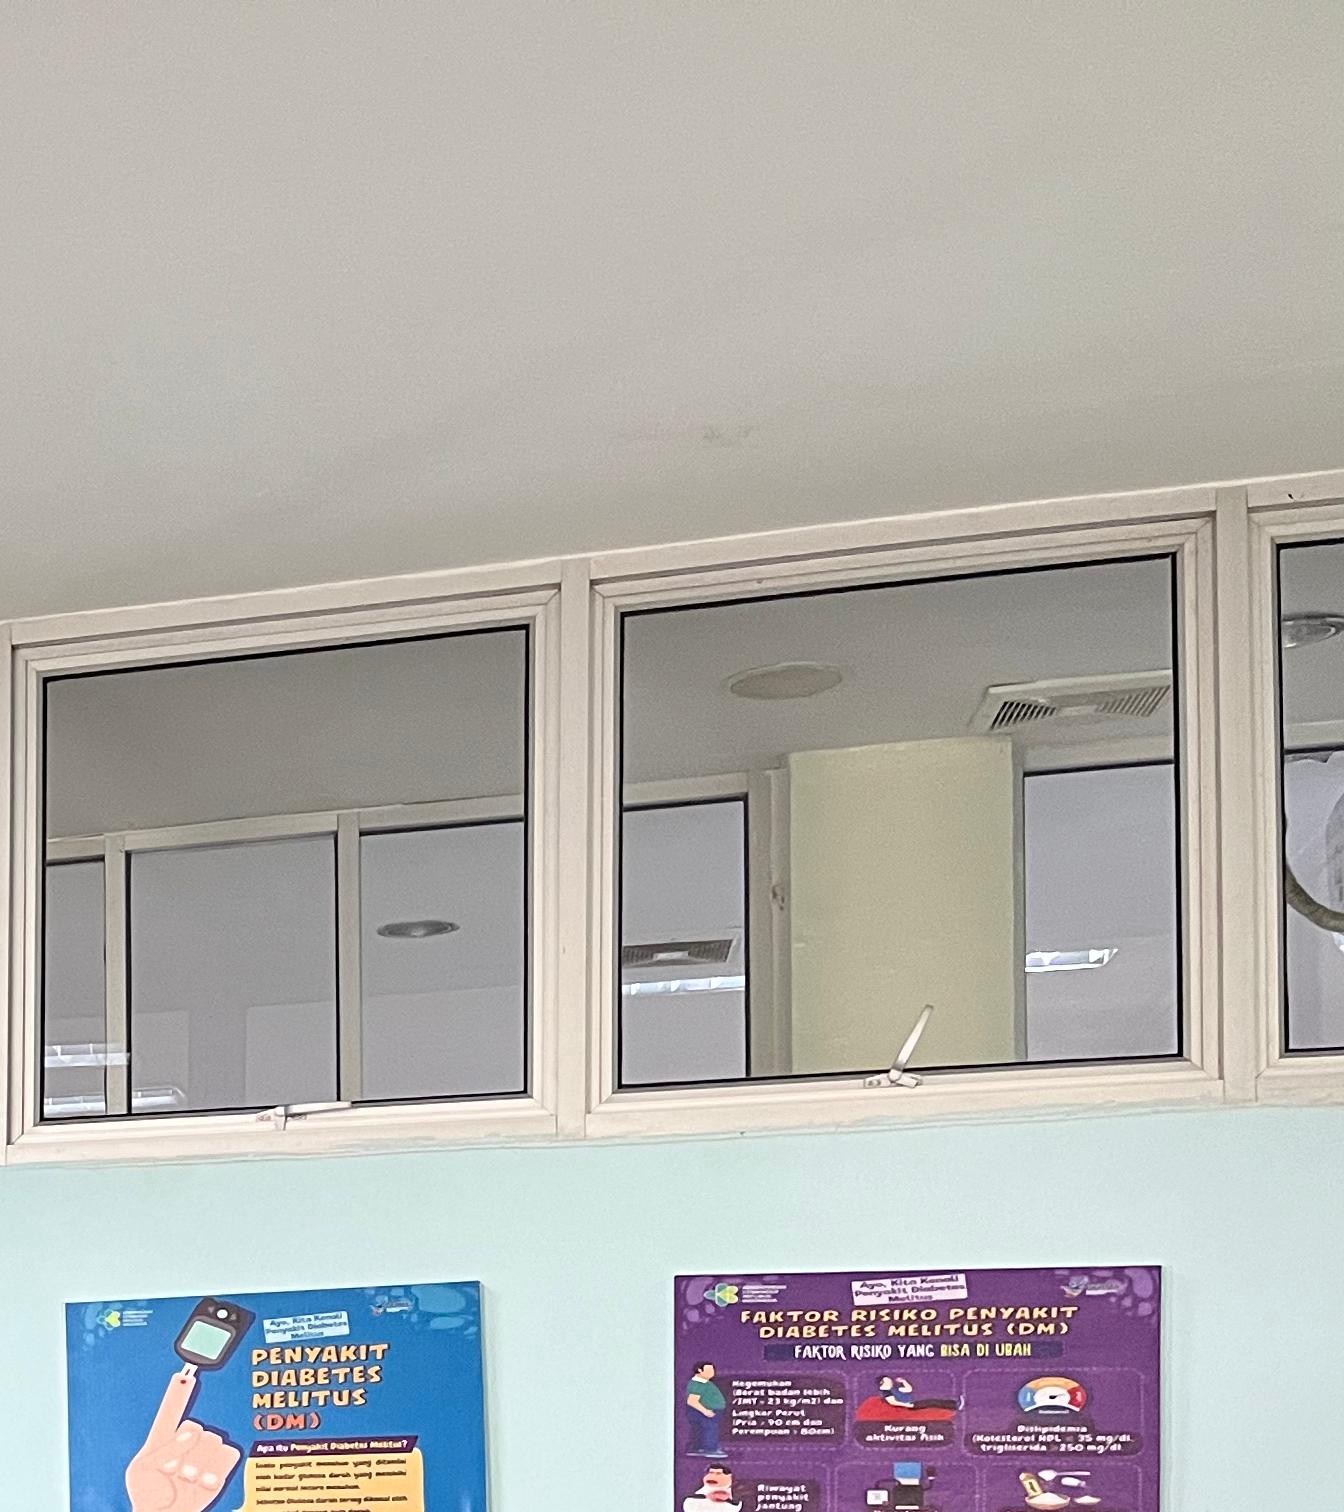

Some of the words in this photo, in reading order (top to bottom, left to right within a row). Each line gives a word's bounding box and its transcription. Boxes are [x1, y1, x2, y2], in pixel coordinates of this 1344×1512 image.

[740, 1310, 839, 1323] FAKTOR
[851, 1308, 938, 1321] RISIKO
[949, 1306, 1079, 1321] PENYAKIT
[759, 1324, 876, 1338] DIABETES
[887, 1322, 993, 1337] MELITUS
[1007, 1322, 1069, 1335] (DM)
[252, 1344, 388, 1365] PENYAKIT
[794, 1345, 846, 1361] FAKTOR
[851, 1345, 892, 1360] RISIKO
[897, 1344, 934, 1357] YANG
[940, 1343, 970, 1357] BISA
[976, 1344, 989, 1357] DI
[995, 1343, 1032, 1357] UBAH
[252, 1366, 381, 1387] DIABETES
[252, 1388, 366, 1408] MELITUS
[254, 1412, 320, 1430] (DM)
